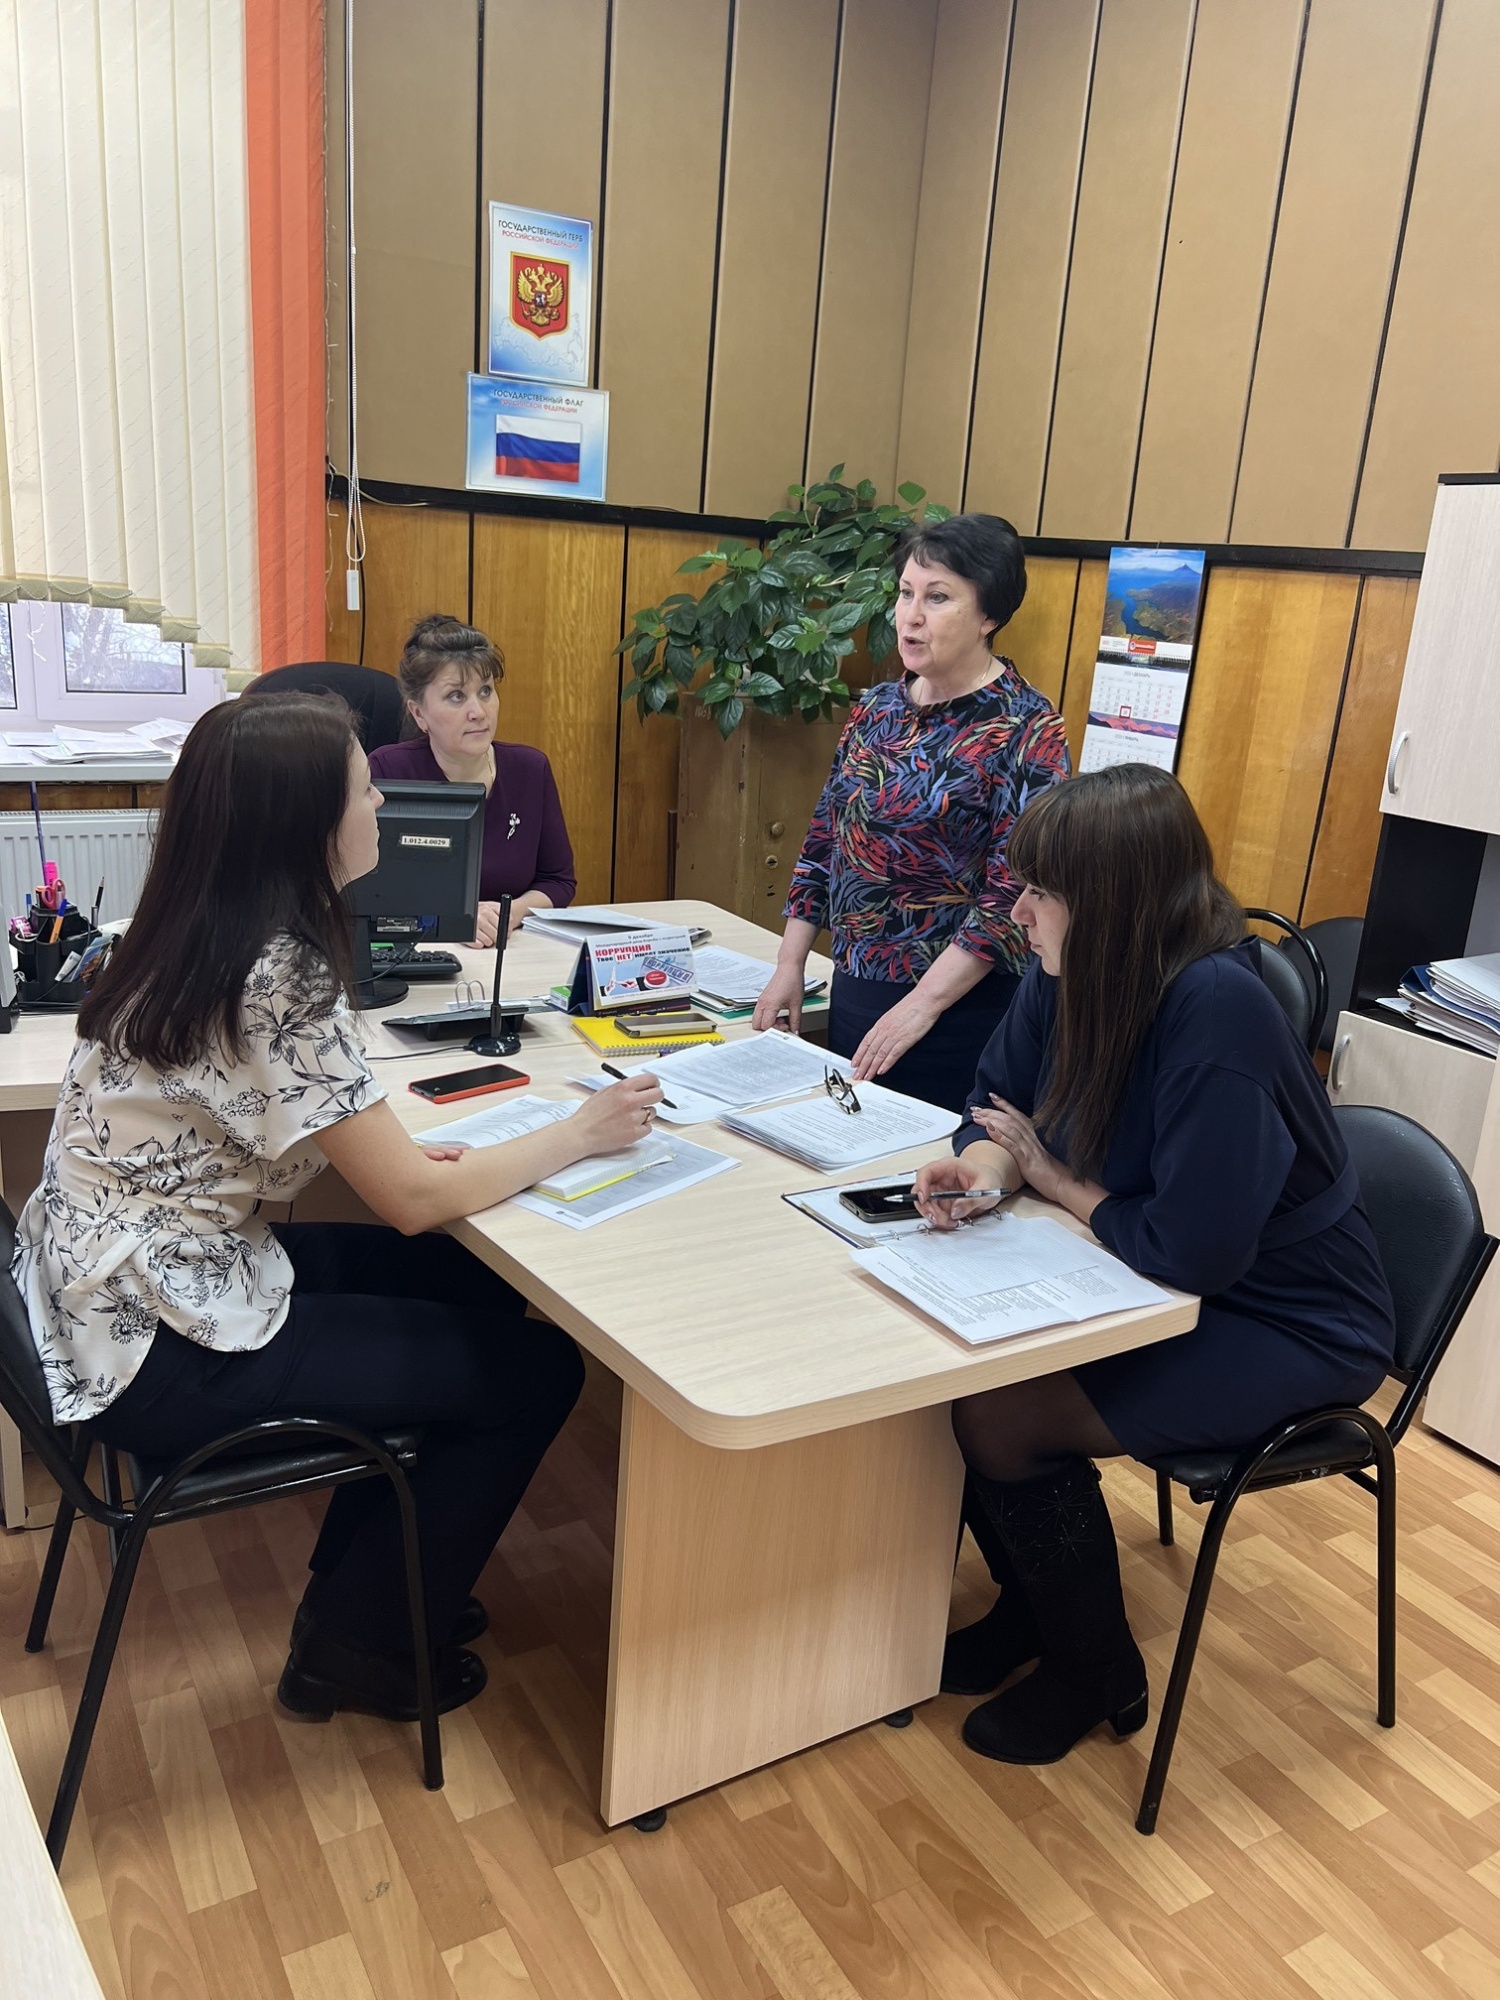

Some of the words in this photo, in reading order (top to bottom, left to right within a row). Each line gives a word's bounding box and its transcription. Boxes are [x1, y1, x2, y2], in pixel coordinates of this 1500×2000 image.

[499, 220, 567, 239] ГОСУДАРСТВЕННЫЙ
[568, 233, 583, 242] ГЕРБ
[502, 230, 544, 243] РОССИЙСКОЙ
[494, 390, 563, 404] ГОСУДАРСТВЕННЫЙ
[565, 398, 584, 407] ФЛАГ
[544, 404, 578, 414] ФЕДЕРАЦИИ
[595, 944, 652, 957] КОРРУПЦИЯ
[647, 959, 691, 981] КОРРУПЦИЯ
